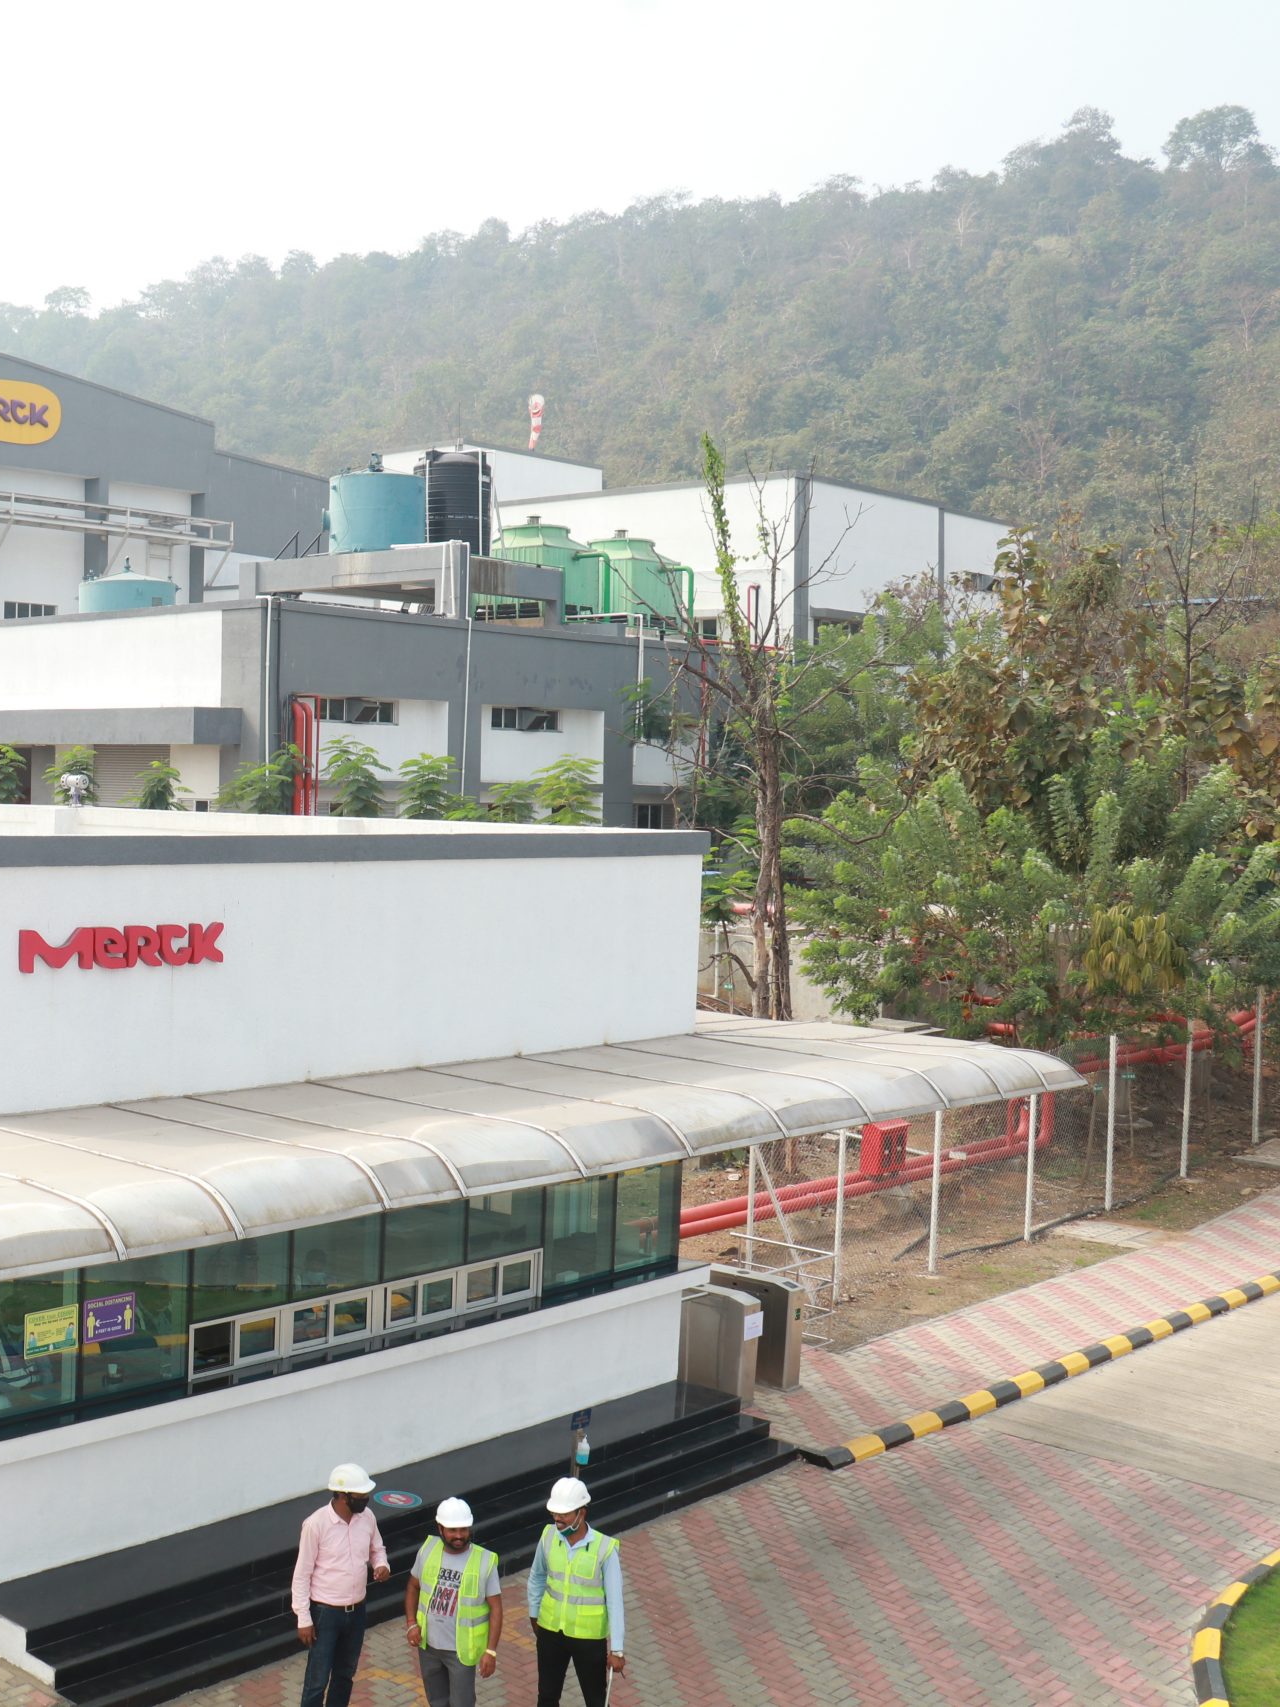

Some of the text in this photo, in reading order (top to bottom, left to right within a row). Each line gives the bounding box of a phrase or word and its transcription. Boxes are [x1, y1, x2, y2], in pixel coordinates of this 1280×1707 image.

[19, 922, 224, 974] MERCK
[87, 1295, 133, 1310] SOCIAL DISTANCING
